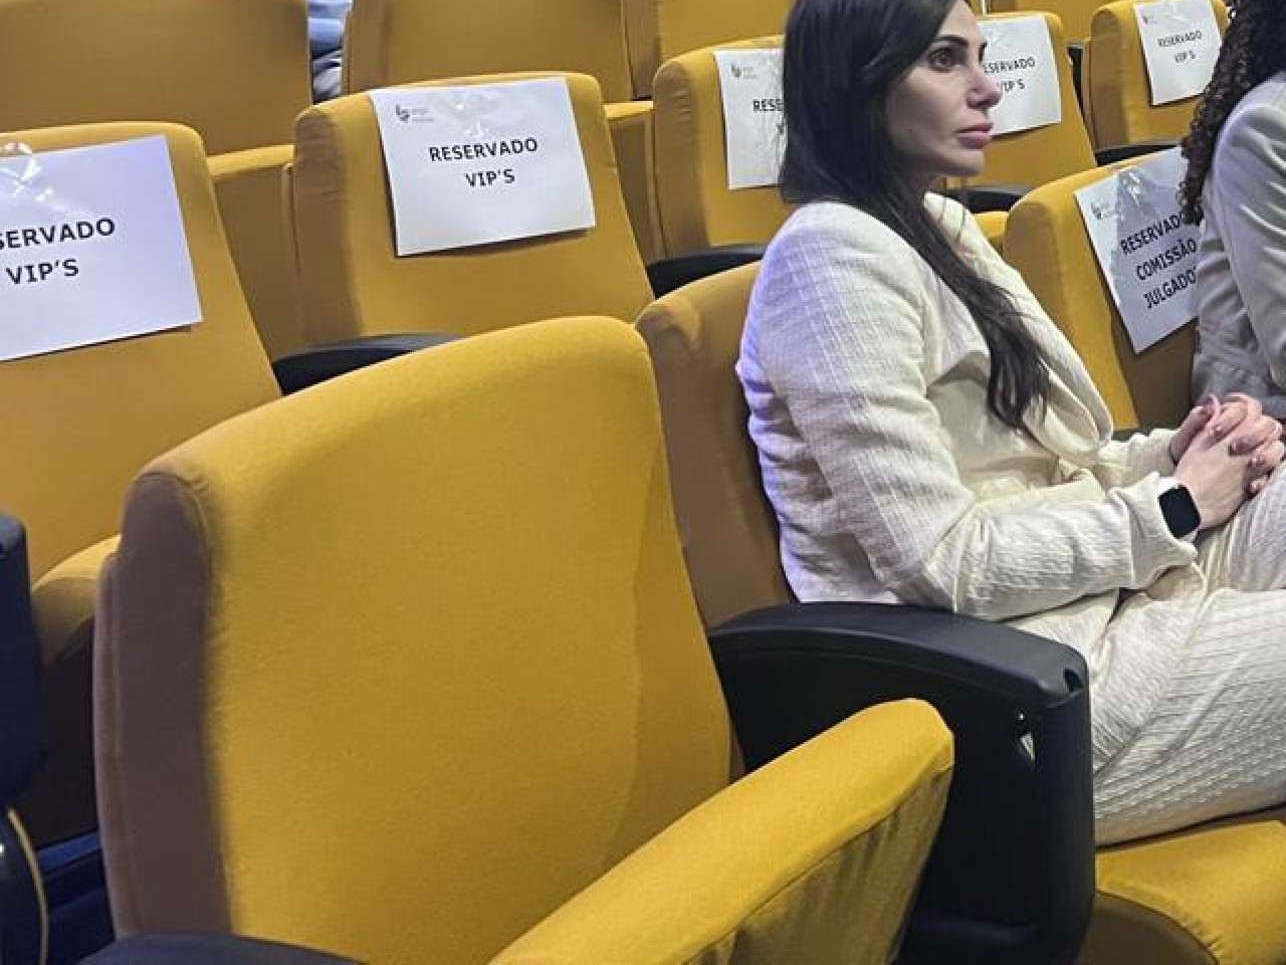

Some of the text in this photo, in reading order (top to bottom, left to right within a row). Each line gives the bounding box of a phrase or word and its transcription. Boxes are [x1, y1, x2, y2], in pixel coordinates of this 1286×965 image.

[983, 57, 1035, 73] ESERVADO
[429, 137, 538, 162] RESERVADO
[465, 168, 516, 187] VIP'S
[1120, 210, 1184, 255] RESERVAD
[5, 258, 79, 285] VIP'S
[1136, 238, 1197, 280] COMISSÃO
[1143, 266, 1197, 308] JULGADO
